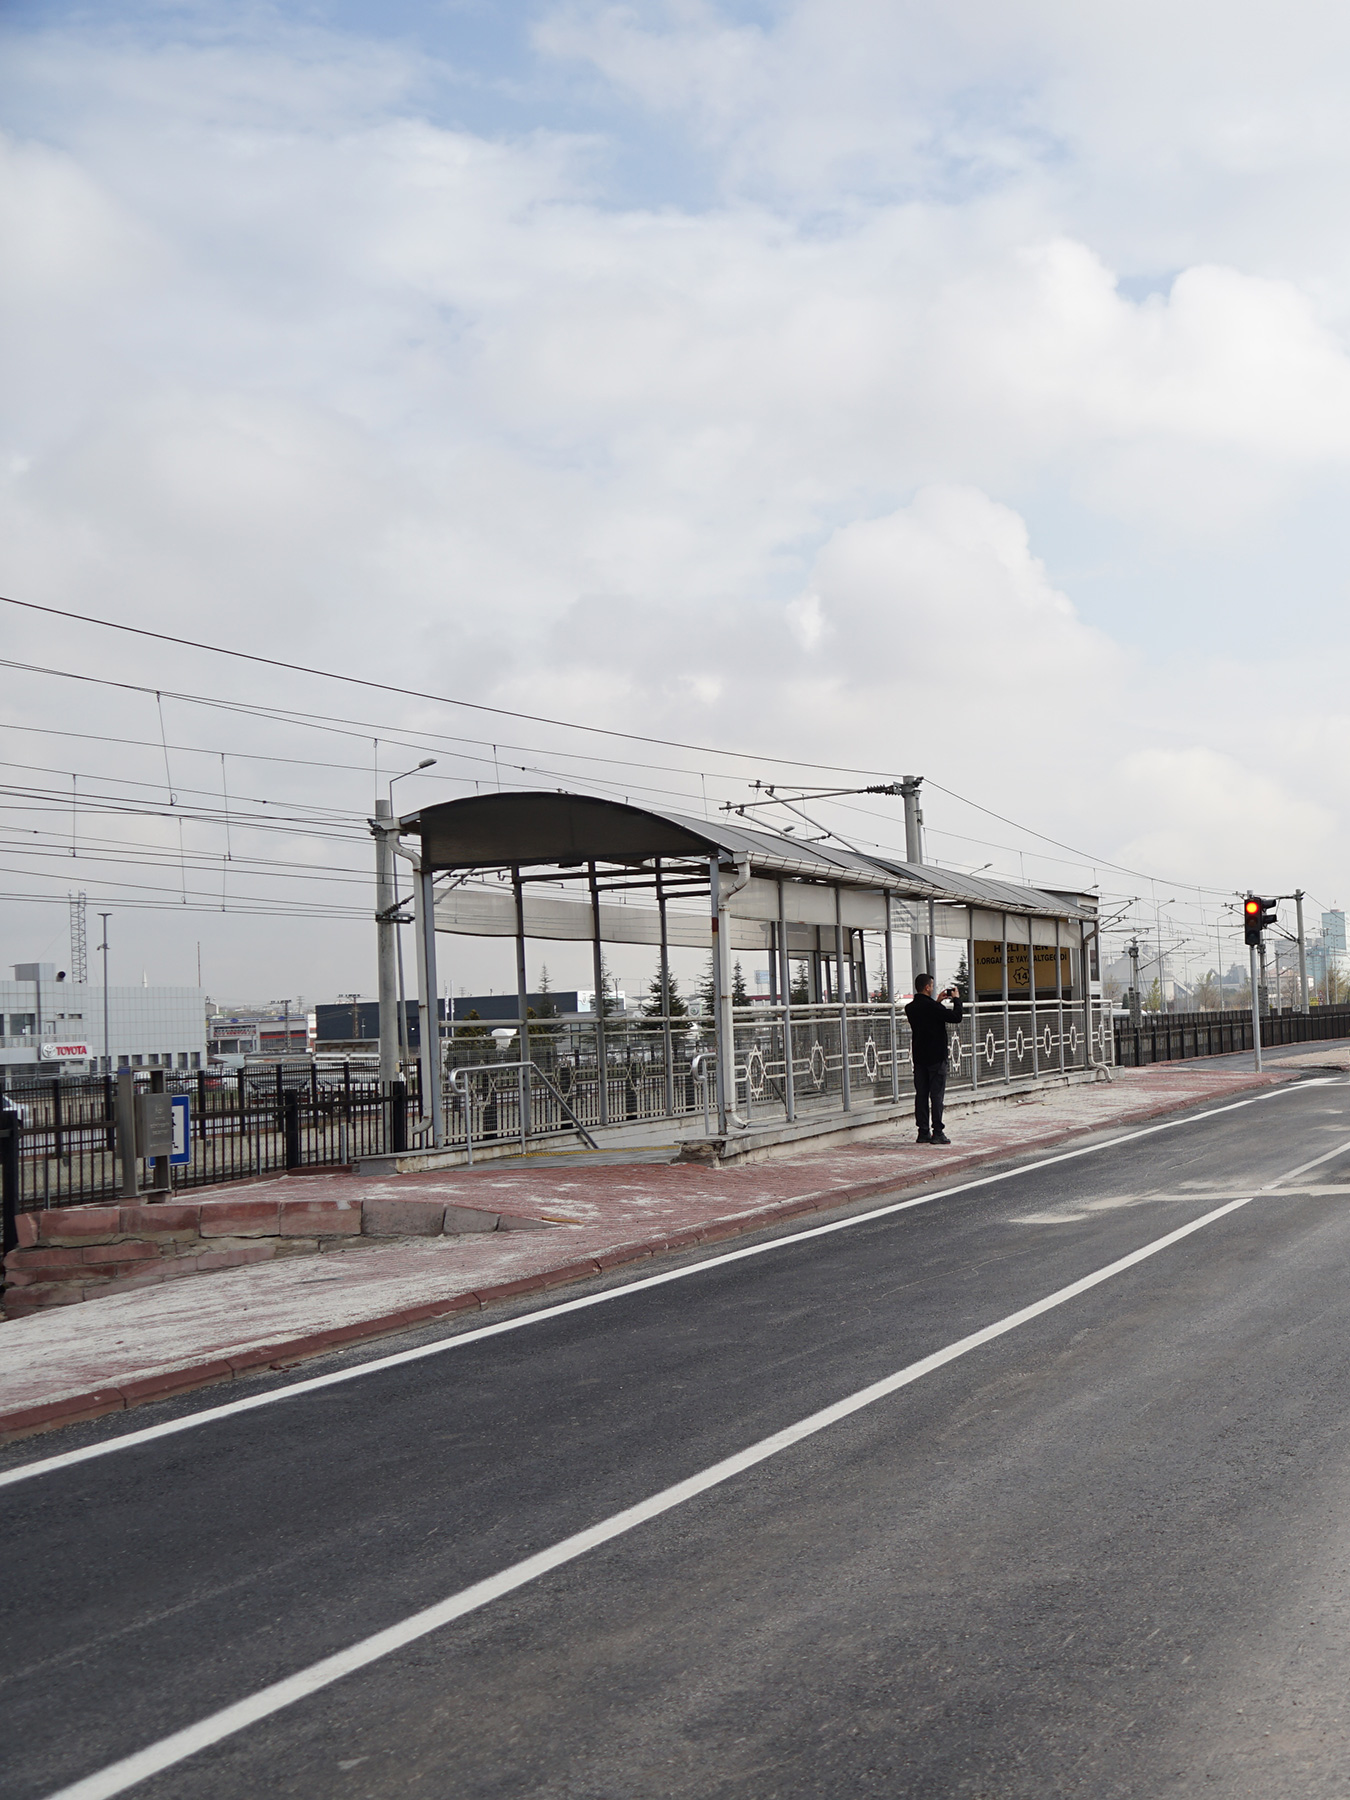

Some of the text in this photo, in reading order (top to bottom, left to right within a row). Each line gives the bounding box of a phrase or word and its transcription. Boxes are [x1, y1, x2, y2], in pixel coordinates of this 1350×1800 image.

[993, 944, 1019, 953] HZLI
[976, 951, 1067, 965] 1.ORGAZE YAY ALTGEDİ
[1017, 972, 1028, 980] 14
[56, 1046, 87, 1056] TOYOTA
